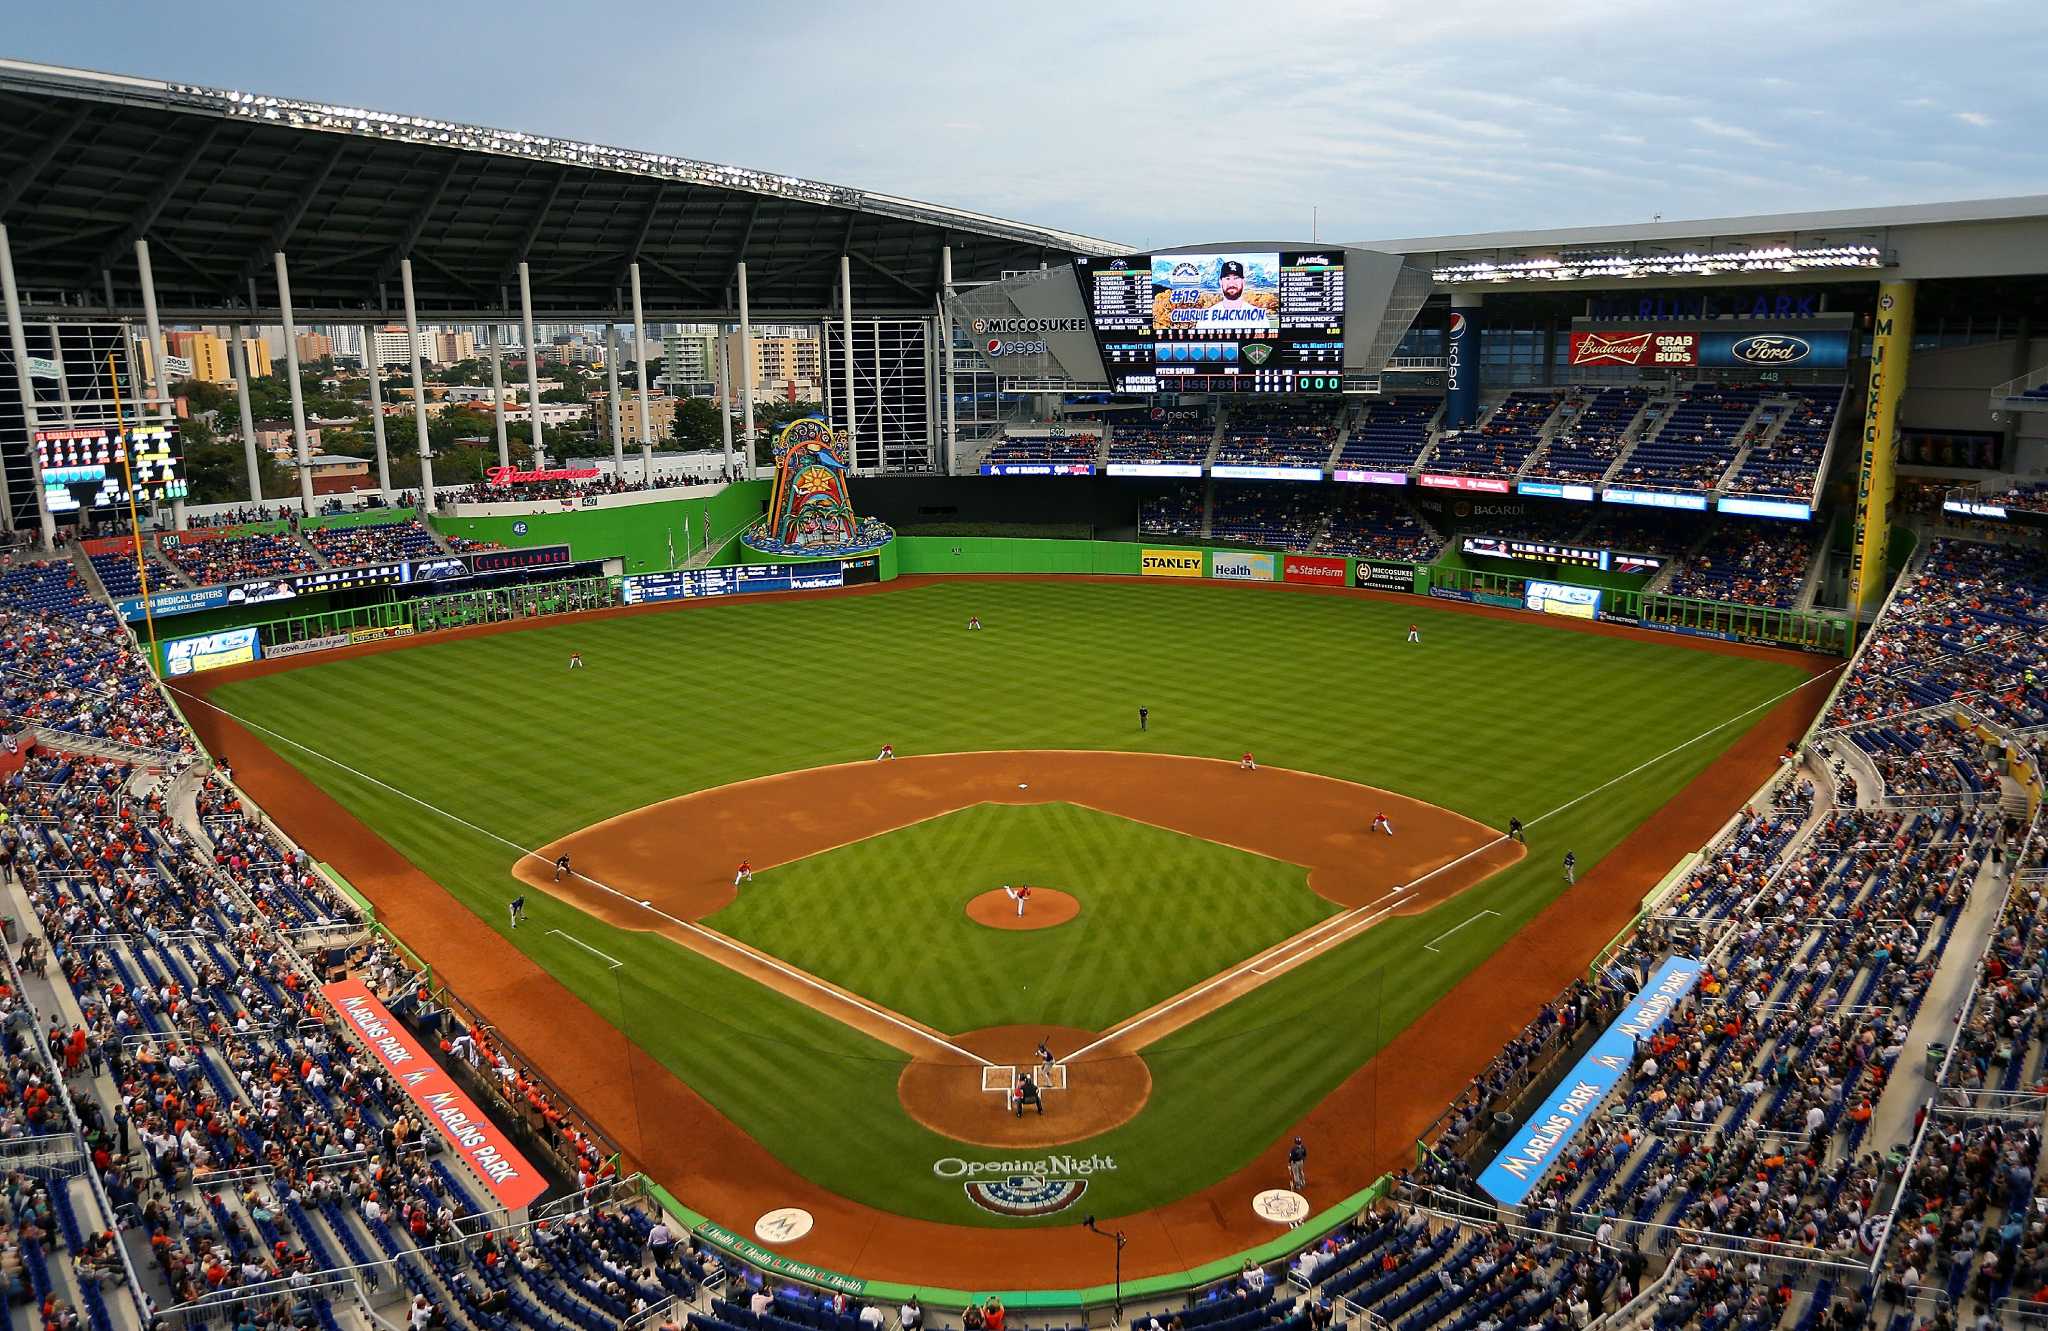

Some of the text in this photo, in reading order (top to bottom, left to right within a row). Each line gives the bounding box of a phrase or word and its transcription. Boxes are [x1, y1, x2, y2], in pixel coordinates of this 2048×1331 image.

[1171, 289, 1199, 303] #19
[1733, 296, 1816, 320] PARK
[1172, 309, 1265, 321] CHARLIE BLACKMON
[988, 318, 1086, 332] MICCOSUKEE
[1655, 336, 1693, 347] GRAB
[1004, 339, 1046, 356] pepsi
[1577, 341, 1648, 355] Budweiser
[1746, 338, 1795, 360] Ford
[167, 357, 187, 366] 2003
[1655, 352, 1691, 363] BUDS
[1448, 341, 1460, 391] pepsi
[1125, 376, 1156, 384] ROCKIES
[1158, 380, 1165, 389] 1
[1300, 378, 1338, 389] 0 0 0
[1125, 384, 1157, 393] MARLINS
[1050, 428, 1066, 437] 502
[485, 465, 600, 486] Budweiser
[583, 497, 597, 506] 427
[513, 524, 527, 533] 42
[162, 535, 180, 546] 401
[475, 554, 567, 570] CLEVELANDER
[1142, 557, 1200, 569] STANLEY
[1215, 565, 1250, 576] Health
[1372, 567, 1413, 577] MICCOSUKEE
[791, 579, 842, 589] MARLINS.COM
[136, 589, 223, 610] LEN MEDICAL CENTERS
[177, 602, 206, 612] EXCELLENCE
[1616, 616, 1638, 624] NETWORK
[1648, 623, 1669, 631] UNITED
[1696, 630, 1718, 638] UNITED
[1617, 969, 1691, 1037] MARLINS PARK
[338, 994, 413, 1066] MARLINS PARK
[1499, 1081, 1600, 1181] MARLINS PARK
[424, 1090, 520, 1185] MARLINS PARK
[933, 1154, 1117, 1177] Opening Night
[710, 1229, 862, 1291] Health Health Health Health
